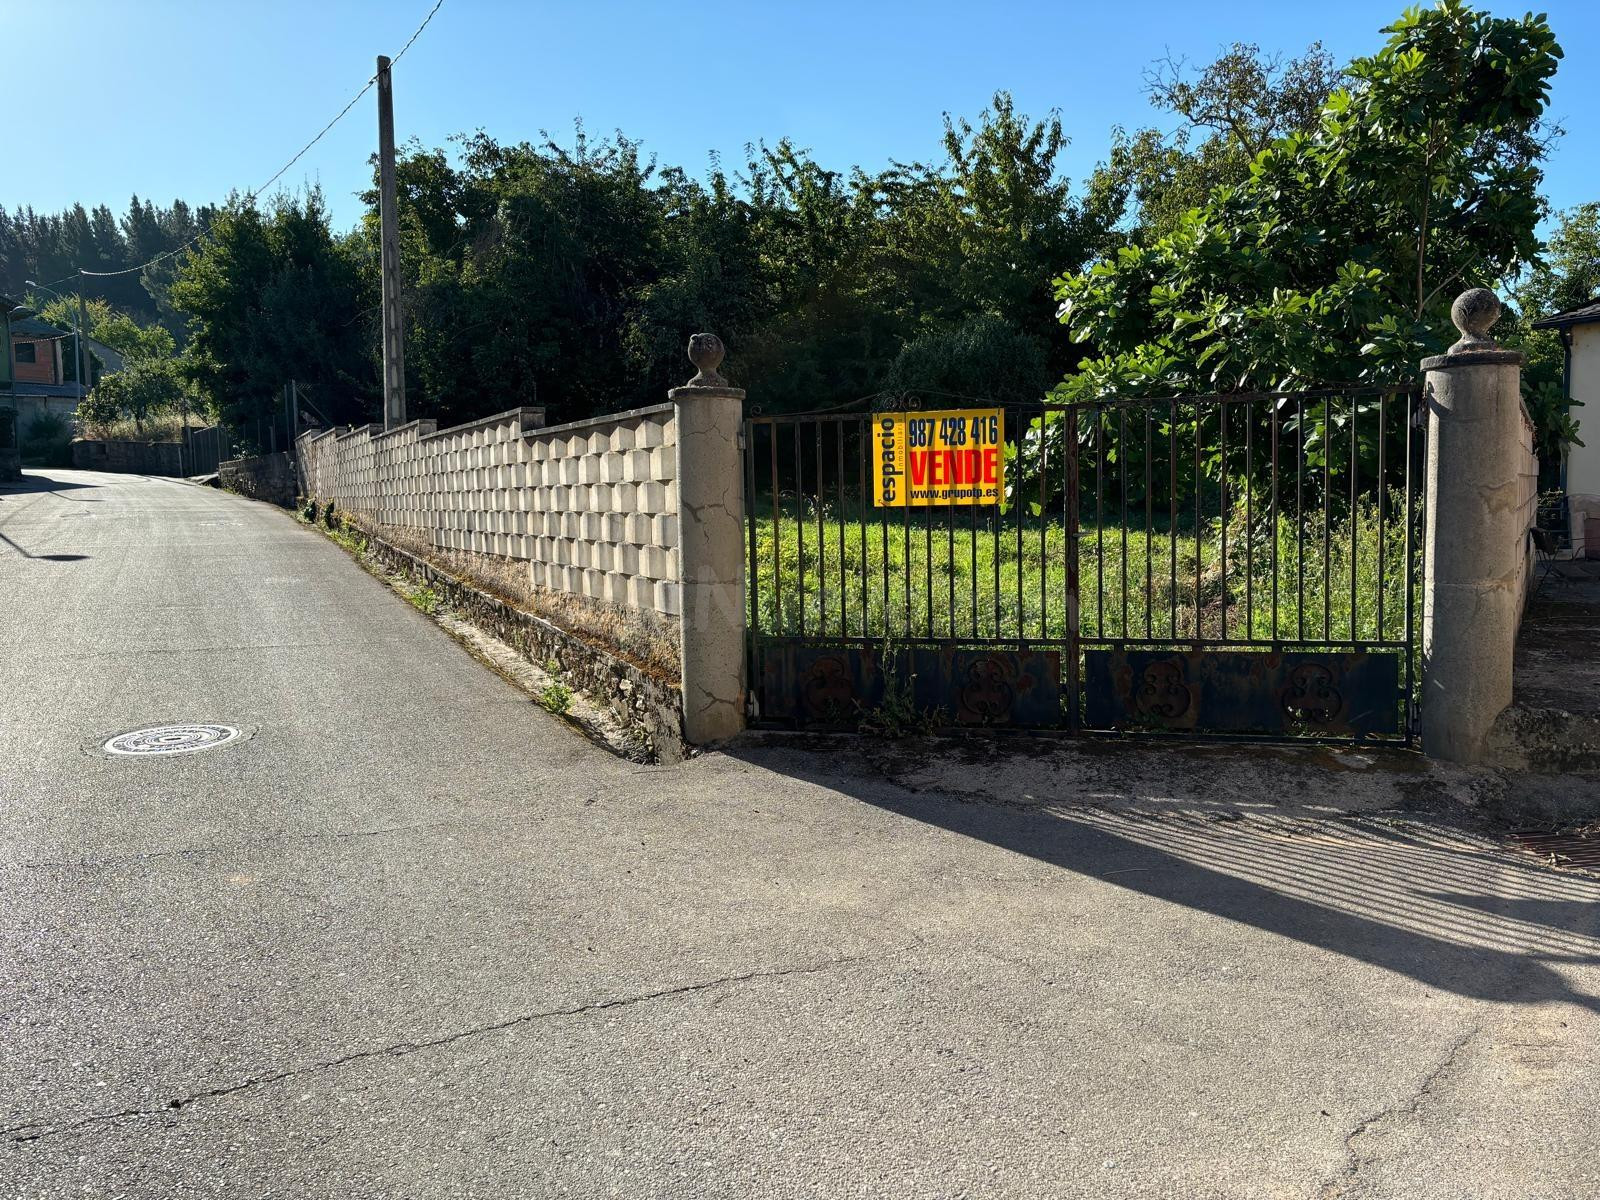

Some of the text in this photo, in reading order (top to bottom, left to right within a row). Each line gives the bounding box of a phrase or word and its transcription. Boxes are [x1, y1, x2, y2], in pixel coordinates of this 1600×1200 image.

[909, 415, 998, 448] 987 428 416
[877, 418, 903, 502] espacio
[909, 448, 998, 486] VENDE
[910, 488, 999, 500] www.grupotp.es
